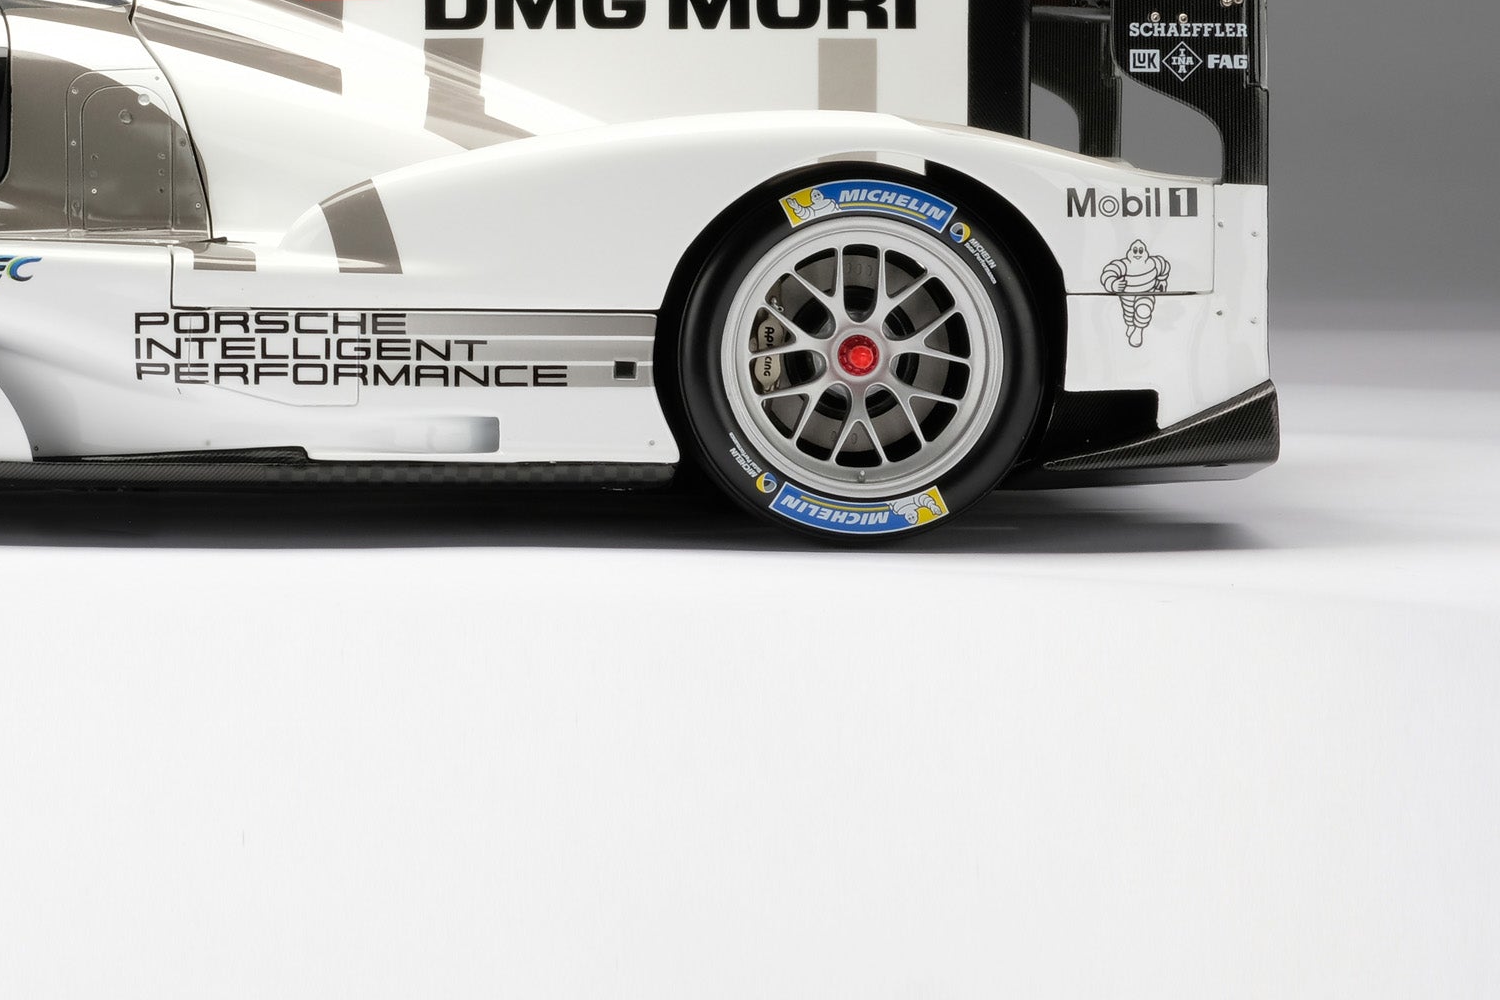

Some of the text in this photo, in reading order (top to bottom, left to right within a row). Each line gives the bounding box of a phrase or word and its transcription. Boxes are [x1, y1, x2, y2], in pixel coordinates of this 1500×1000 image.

[1129, 22, 1248, 37] SCHAEFFLER
[1207, 54, 1248, 69] FAG
[838, 188, 947, 221] MICHELIN
[1066, 187, 1192, 218] Mobil 1
[969, 237, 997, 269] MICHELIN
[134, 312, 407, 335] PORSCHE
[134, 337, 487, 362] INTELLIGENT
[134, 362, 568, 387] PERFORMANCE
[729, 447, 759, 478] MICHELIN
[780, 494, 890, 525] MICHELIN
